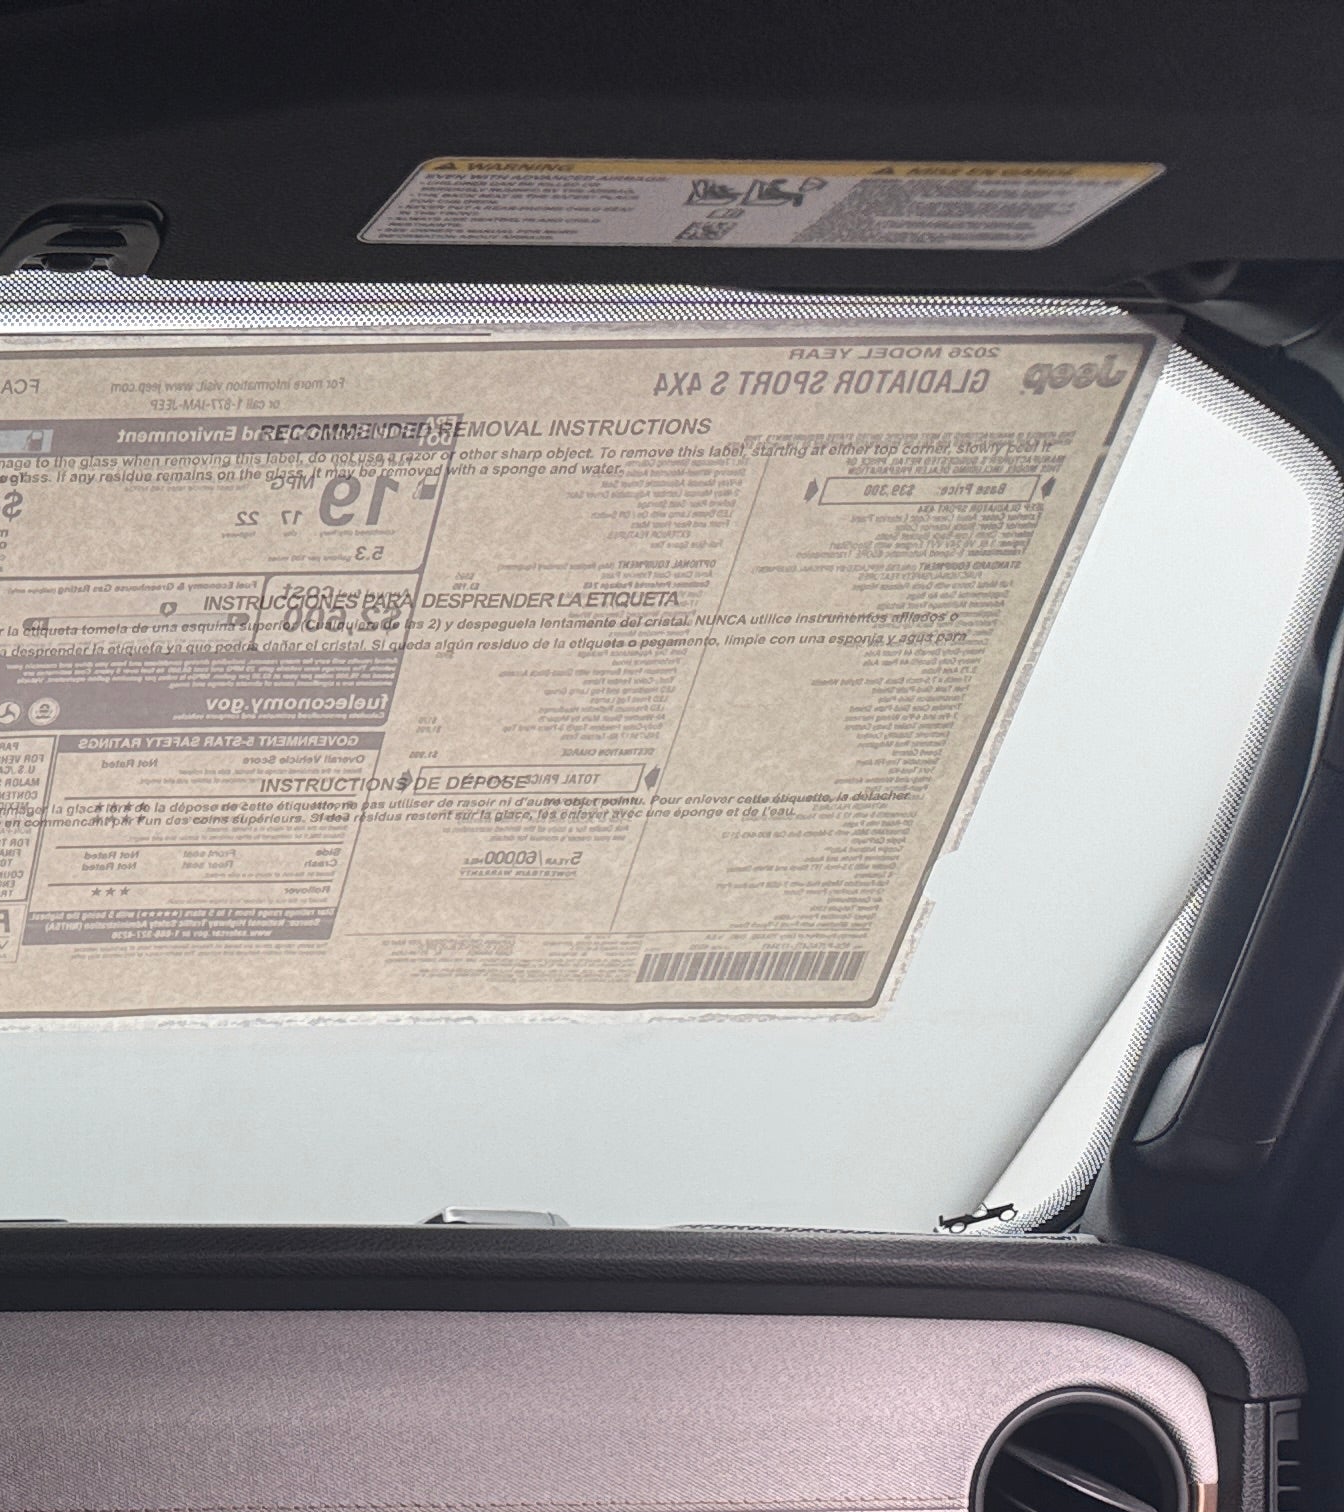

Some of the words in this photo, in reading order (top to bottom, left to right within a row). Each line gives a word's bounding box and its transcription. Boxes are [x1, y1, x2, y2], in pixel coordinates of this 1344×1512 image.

[466, 161, 575, 172] WARNING
[261, 422, 433, 441] RECOMMENDED
[437, 419, 543, 438] REMOVAL
[548, 417, 712, 438] INSTRUCTIONS
[36, 458, 50, 470] to
[54, 456, 75, 470] the
[79, 456, 118, 472] glass
[123, 455, 160, 469] when
[164, 454, 231, 471] removing
[235, 453, 262, 466] this
[460, 448, 498, 461] other
[502, 447, 542, 463] sharp
[547, 447, 595, 463] object.
[600, 447, 616, 460] To
[621, 447, 673, 459] remove
[678, 446, 705, 458] this
[709, 444, 745, 460] label,
[204, 594, 359, 611] INSTRUCCIONES
[362, 593, 414, 609] PARA
[422, 593, 553, 609] DESPRENDER
[557, 592, 583, 608] LA
[585, 591, 679, 608] ETIQUETA
[261, 776, 409, 793] INSTRUCTIONS
[413, 777, 440, 791] DE
[445, 773, 528, 790] DÉPOSE
